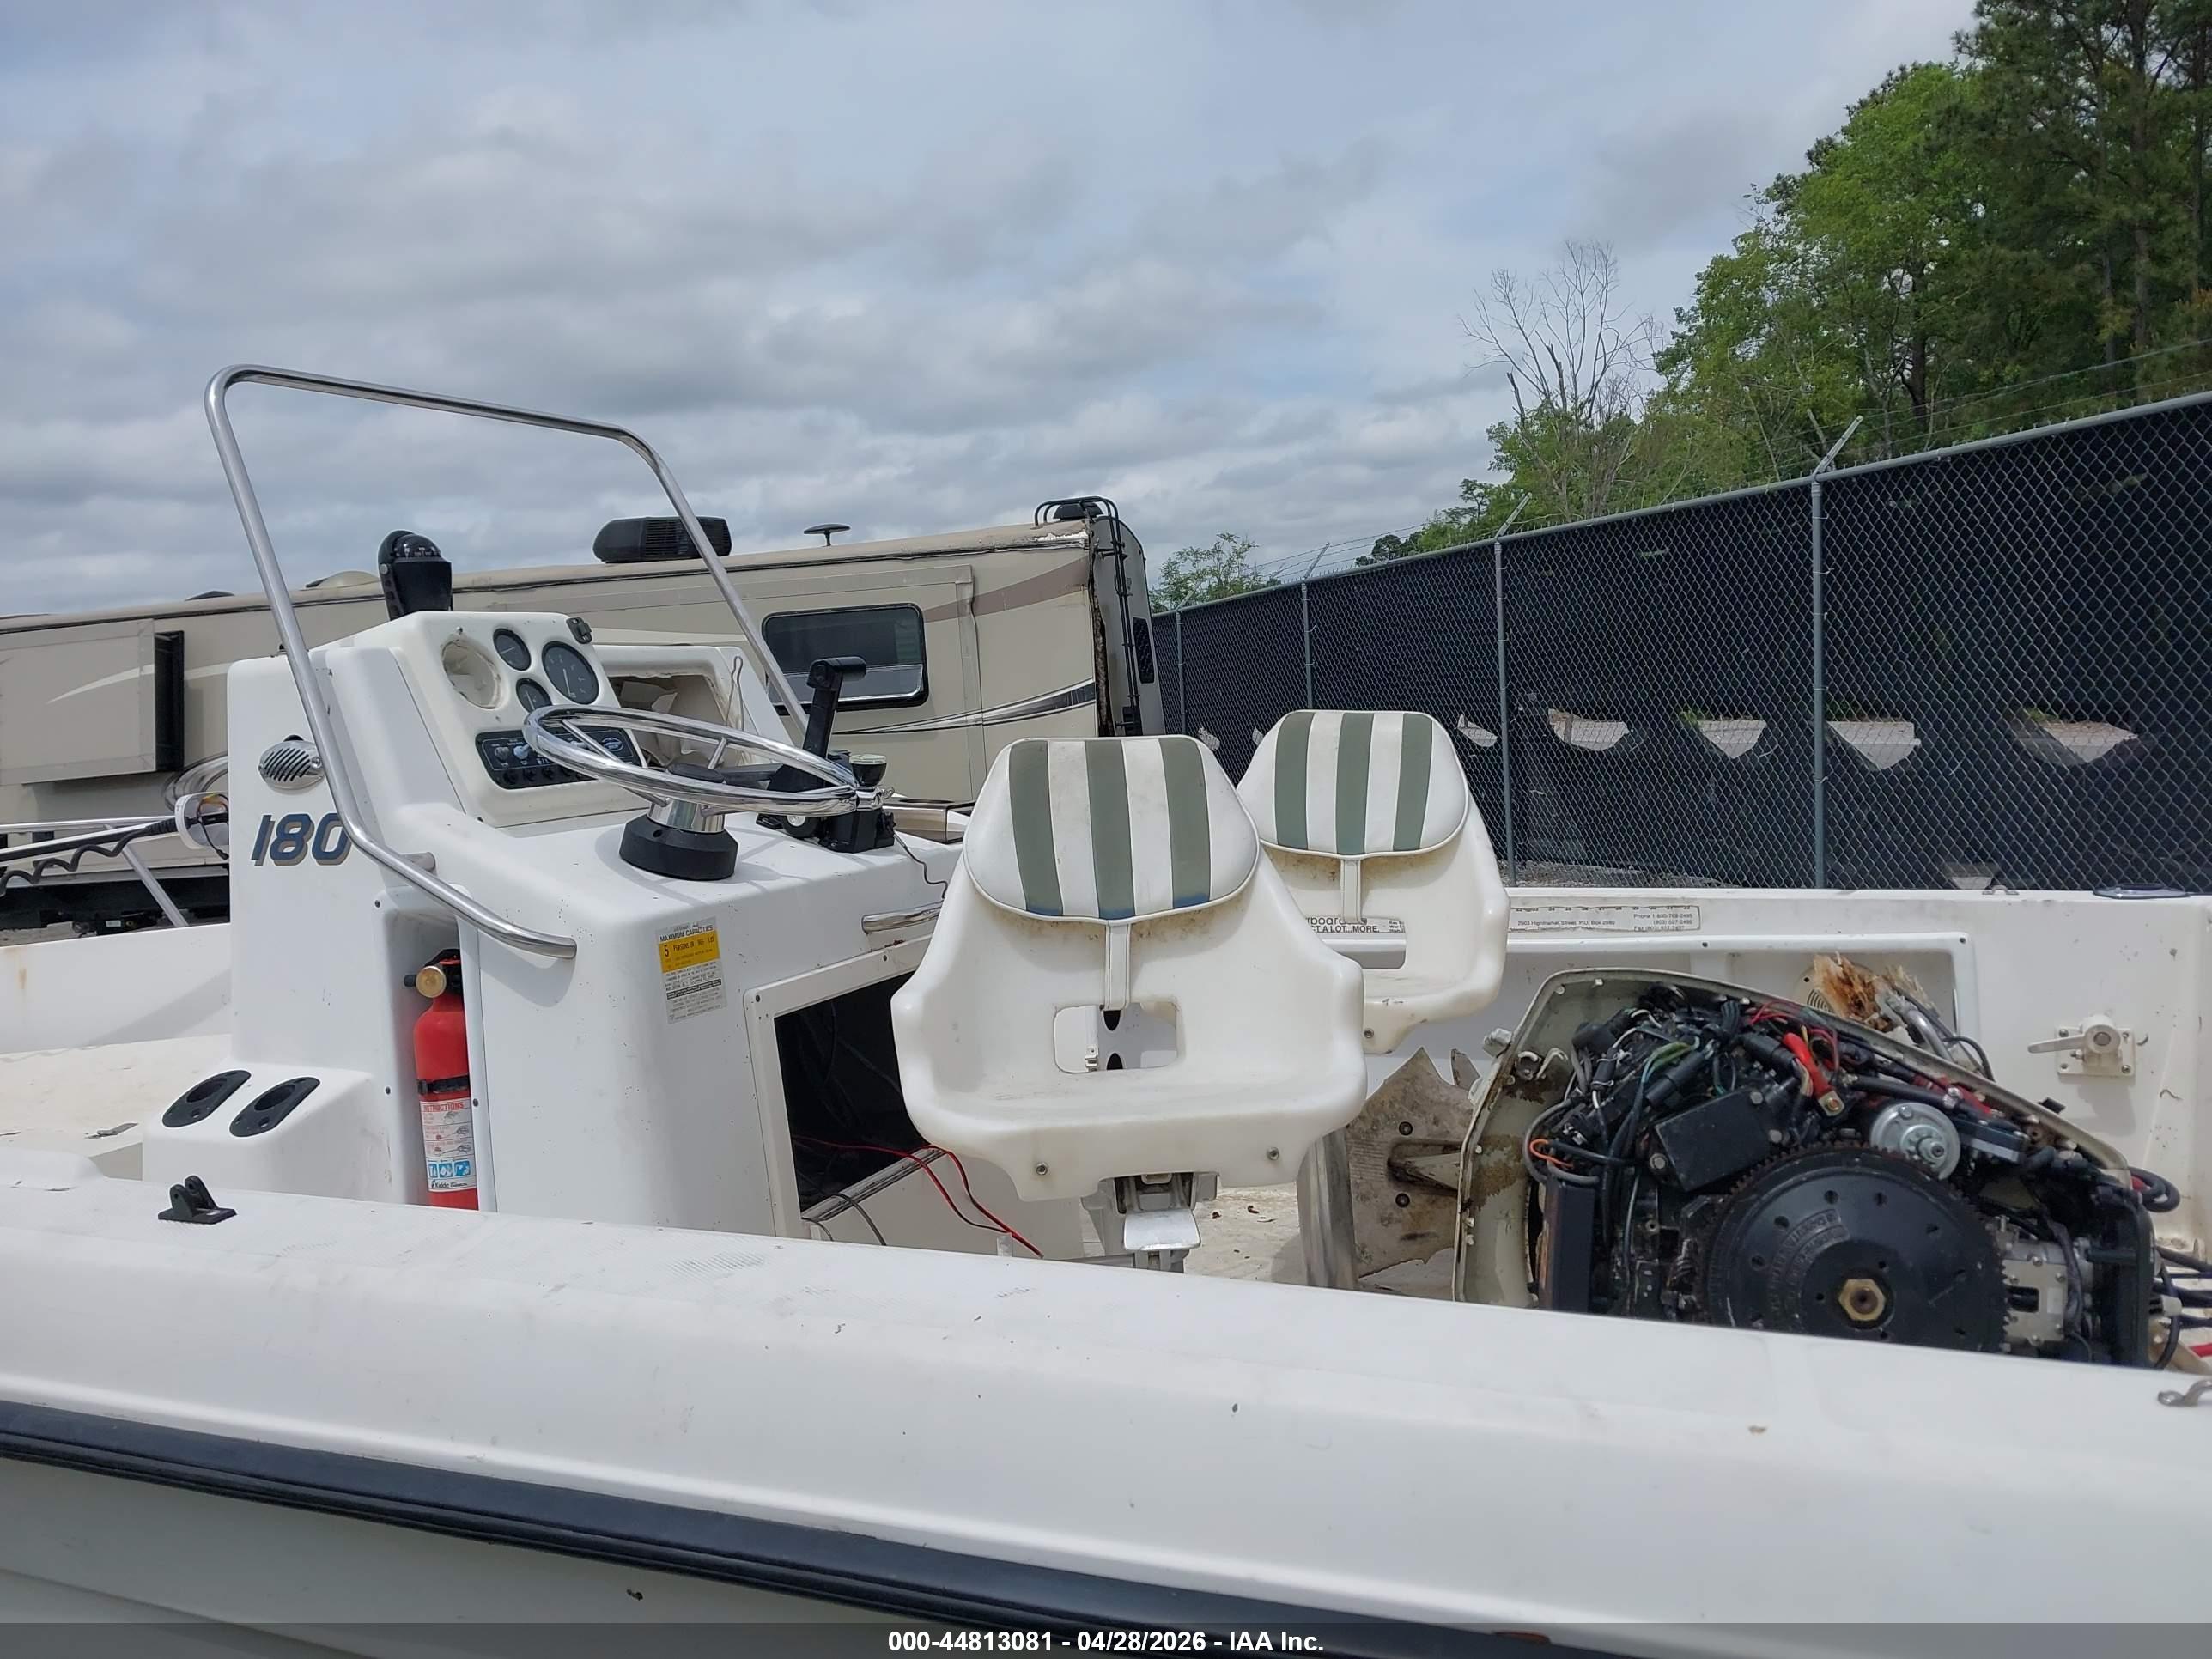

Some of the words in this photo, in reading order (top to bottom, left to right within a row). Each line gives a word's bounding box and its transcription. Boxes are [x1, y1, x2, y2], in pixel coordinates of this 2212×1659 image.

[251, 812, 351, 866] 180
[659, 931, 684, 942] MAXIMUM
[685, 925, 714, 937] CAPACITIES
[664, 945, 670, 957] 5
